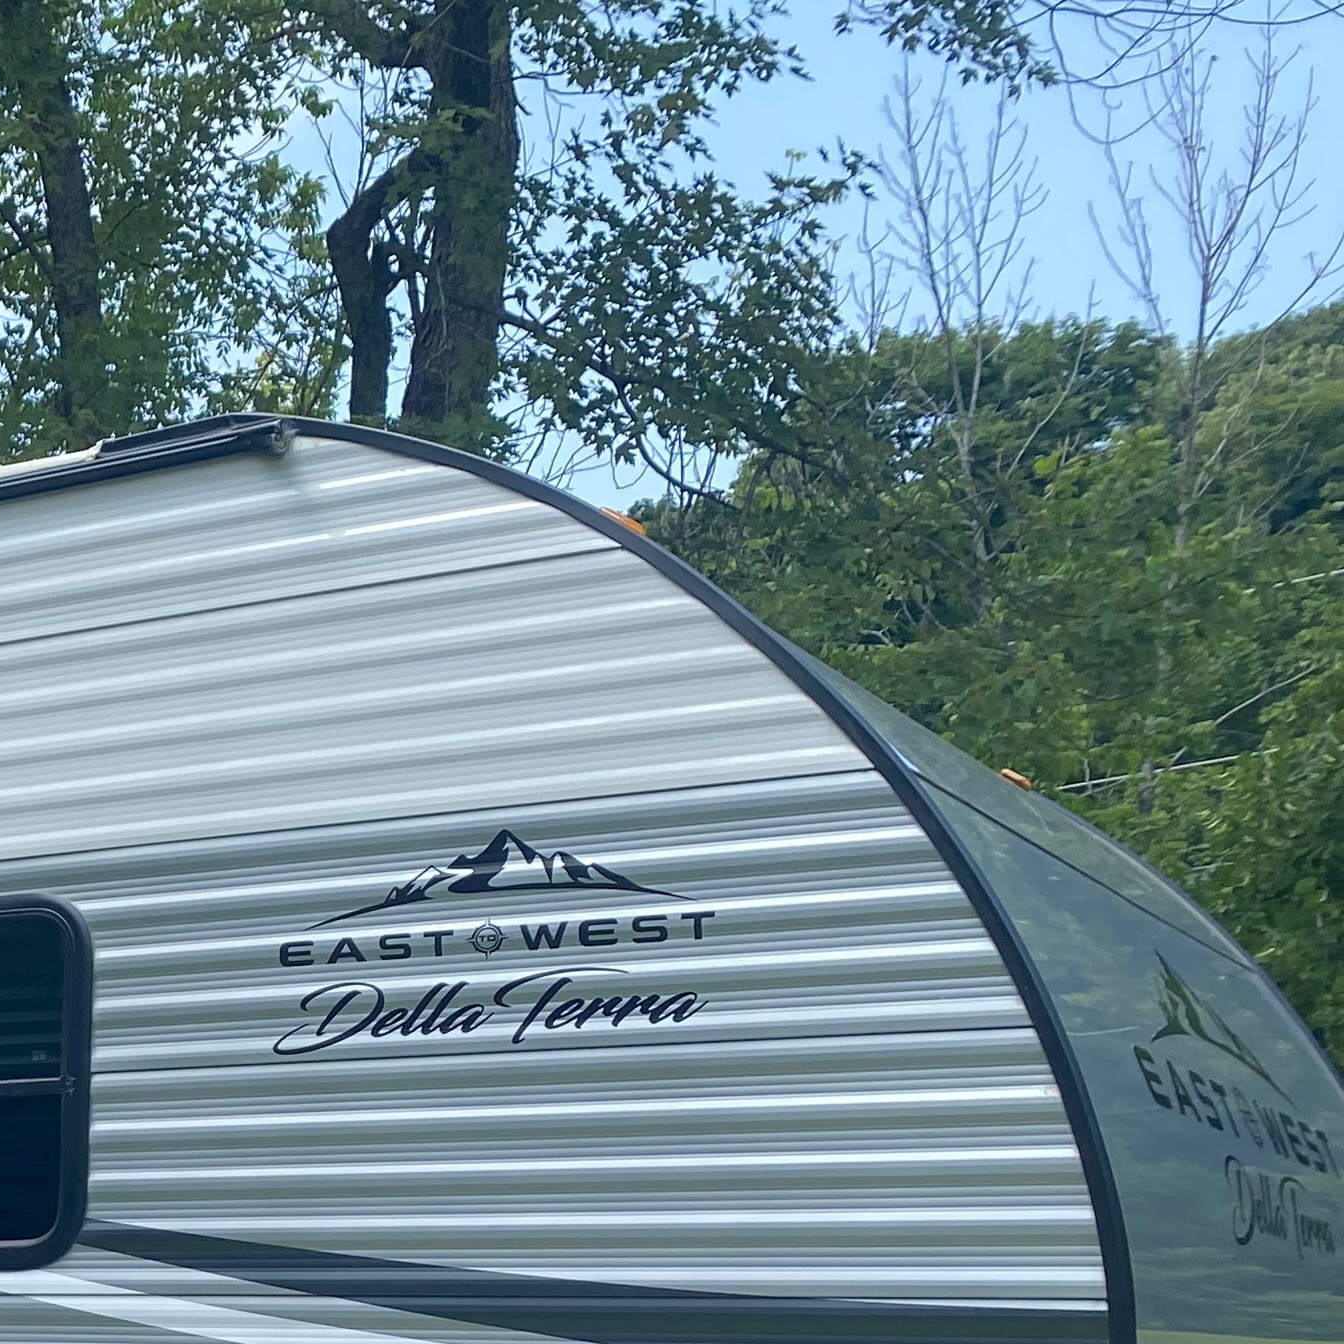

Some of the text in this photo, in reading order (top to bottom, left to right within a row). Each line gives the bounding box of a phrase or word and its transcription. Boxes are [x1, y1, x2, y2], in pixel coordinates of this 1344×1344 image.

[279, 930, 455, 967] EAST
[519, 911, 716, 951] WEST
[273, 967, 709, 1056] Della Terra
[1133, 1044, 1341, 1180] EAST WEST
